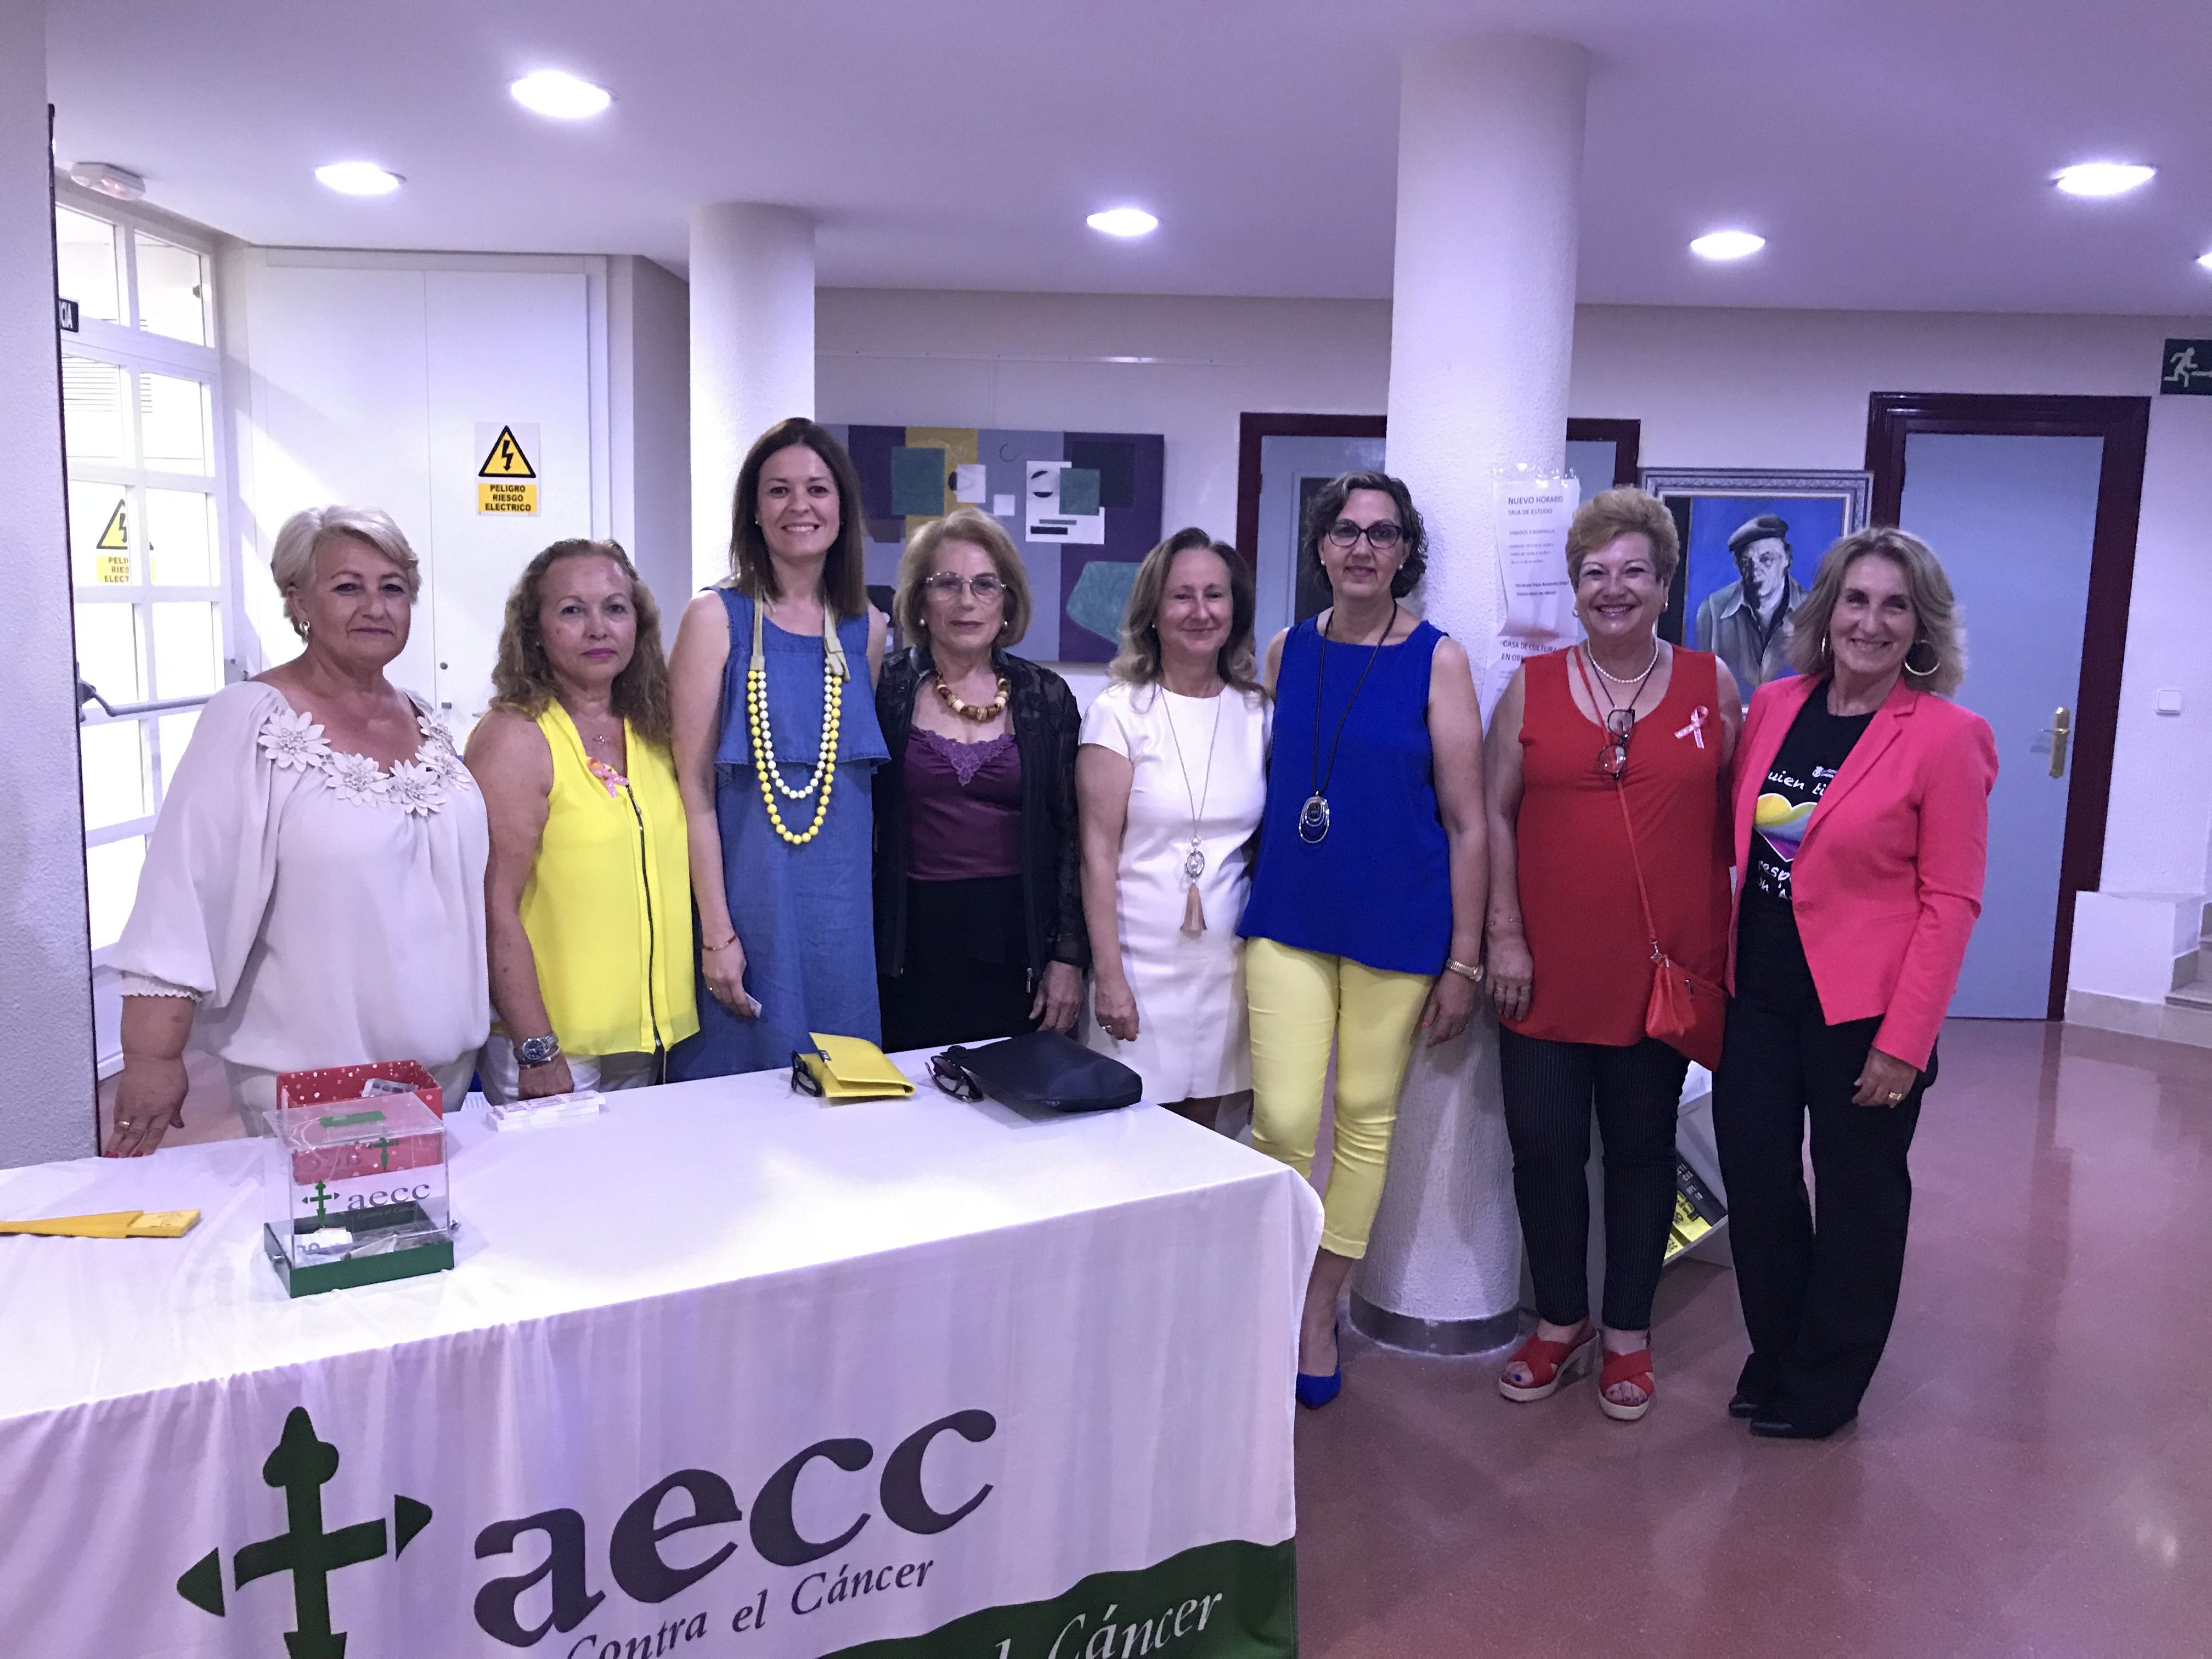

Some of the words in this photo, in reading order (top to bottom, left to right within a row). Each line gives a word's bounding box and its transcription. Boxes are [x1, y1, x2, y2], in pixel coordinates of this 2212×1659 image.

[490, 484, 526, 492] PELIGRO
[485, 503, 531, 511] ELECTRICO
[1529, 644, 1557, 652] CULTURA
[1768, 770, 1804, 790] uien
[1812, 782, 1826, 795] ti
[347, 1184, 430, 1211] aecc
[474, 1409, 997, 1647] aecc
[567, 1611, 708, 1659] Contra
[731, 1588, 769, 1633] el
[791, 1559, 934, 1616] Cáncer
[1048, 1592, 1222, 1659] Cáncer
